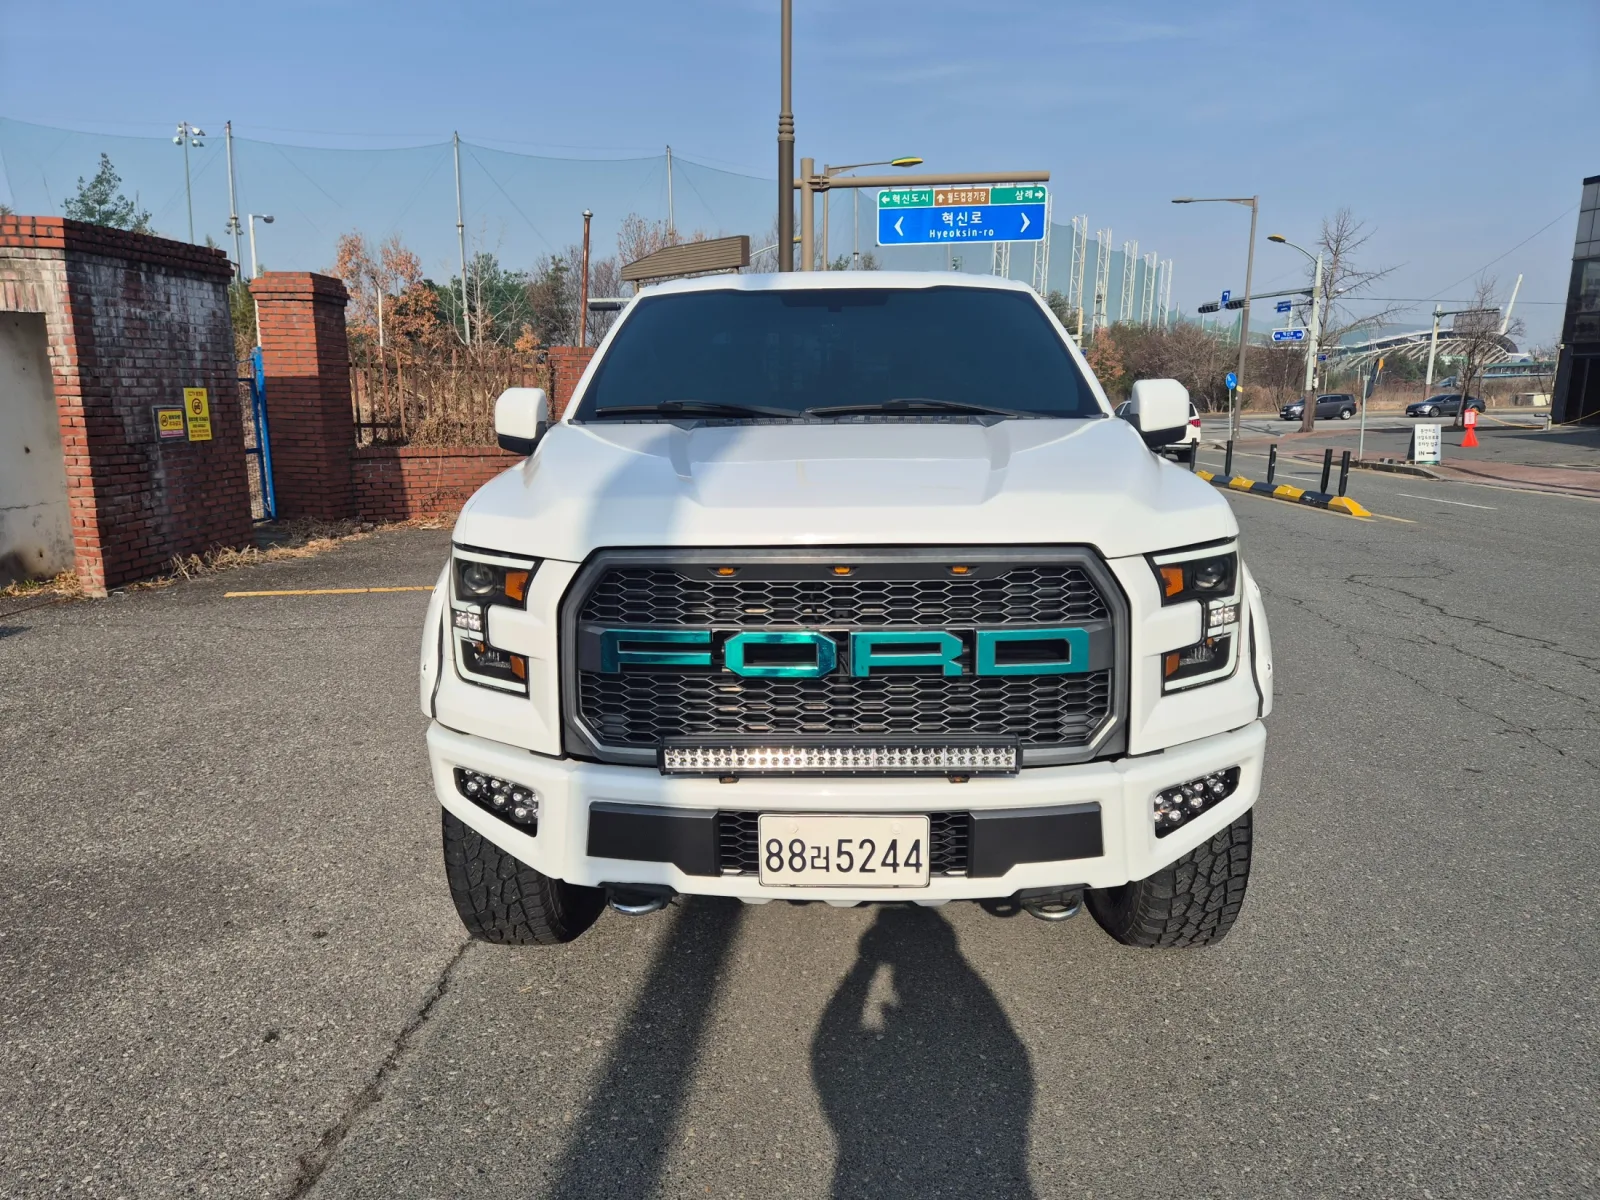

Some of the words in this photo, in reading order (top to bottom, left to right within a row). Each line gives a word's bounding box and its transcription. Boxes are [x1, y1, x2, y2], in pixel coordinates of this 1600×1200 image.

[892, 193, 929, 205] 혁신도시
[947, 191, 986, 204] 월드컵경기장
[1015, 189, 1033, 201] 삼례
[941, 210, 983, 227] 혁신로
[929, 228, 994, 240] Hyeoksin-ro
[600, 628, 1090, 678] FORD
[765, 838, 923, 873] 88러5244
